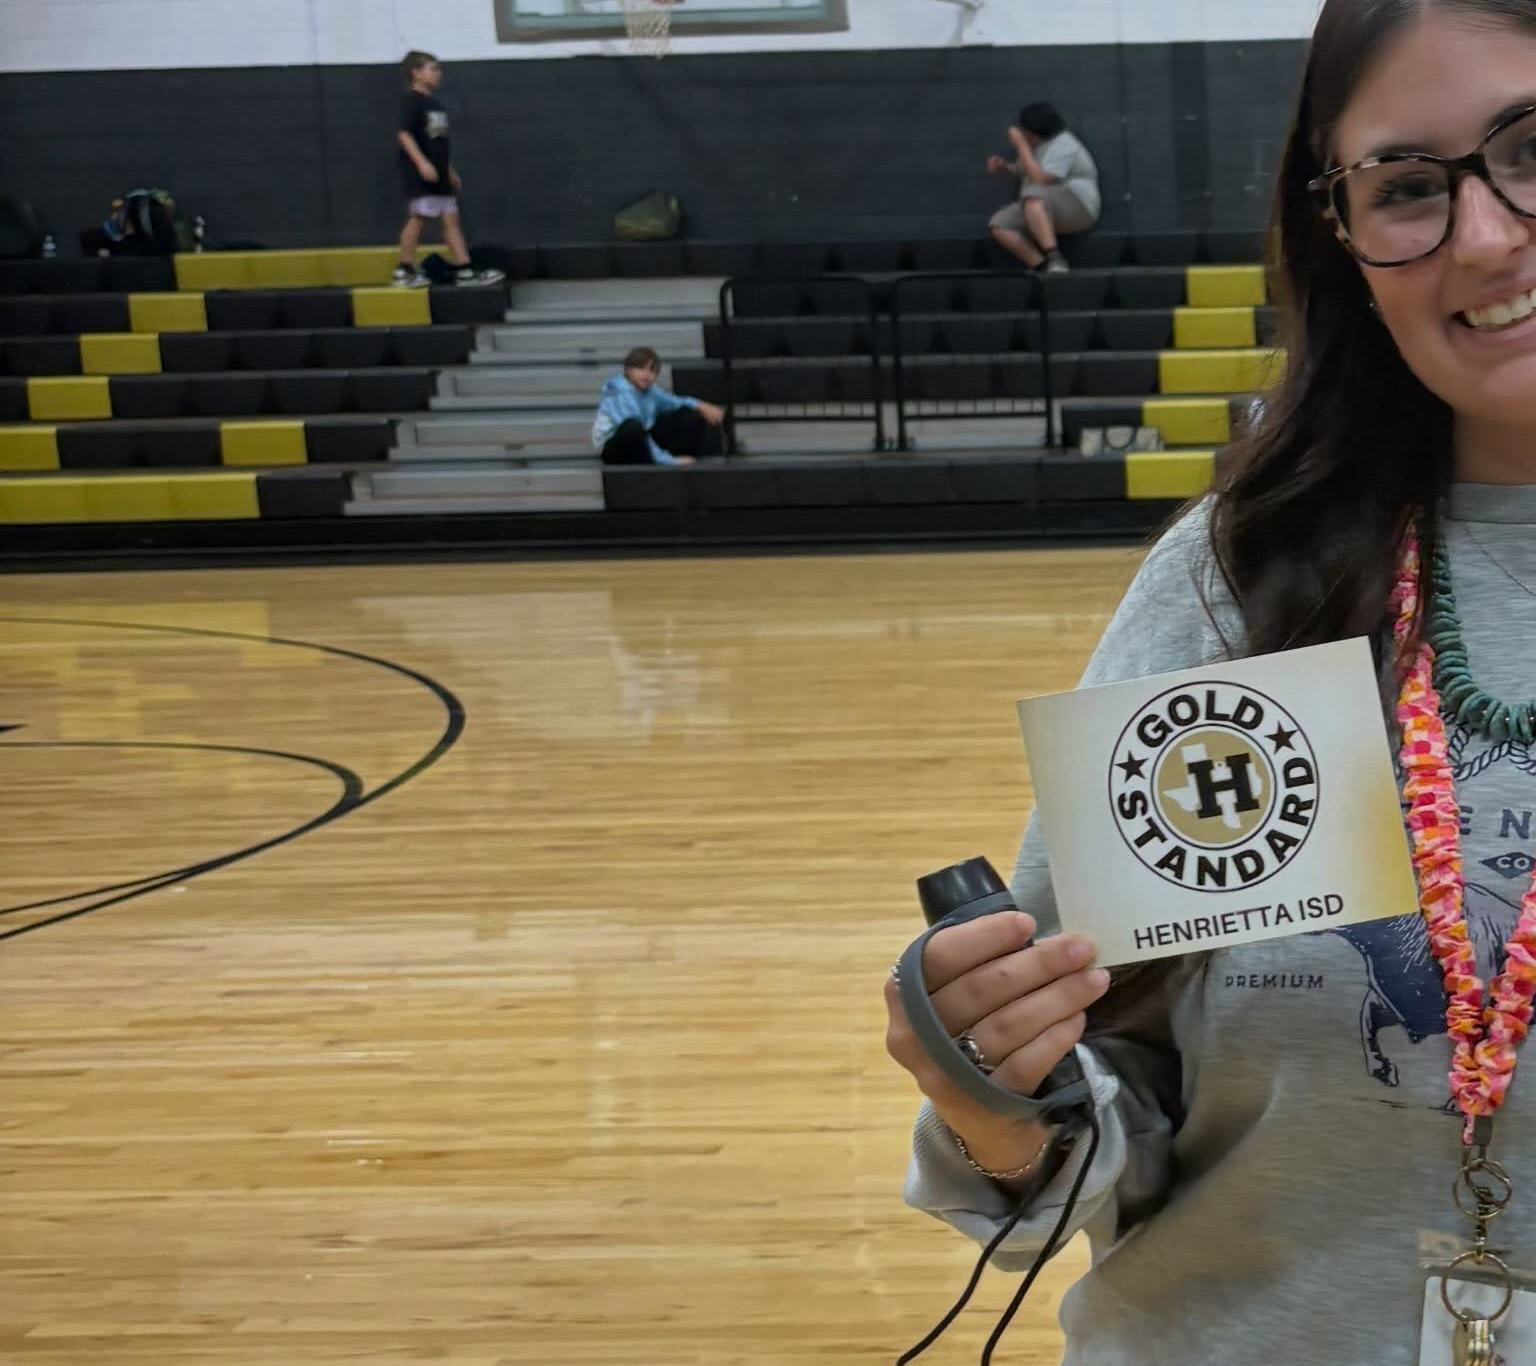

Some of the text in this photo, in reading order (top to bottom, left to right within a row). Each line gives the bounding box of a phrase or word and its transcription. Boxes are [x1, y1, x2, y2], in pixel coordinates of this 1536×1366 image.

[1136, 690, 1264, 749] GOLD
[1188, 752, 1260, 819] H
[1117, 756, 1316, 888] STANDARD
[1133, 893, 1345, 950] HENRIETTA ISD
[1225, 974, 1326, 988] PREMIUM
